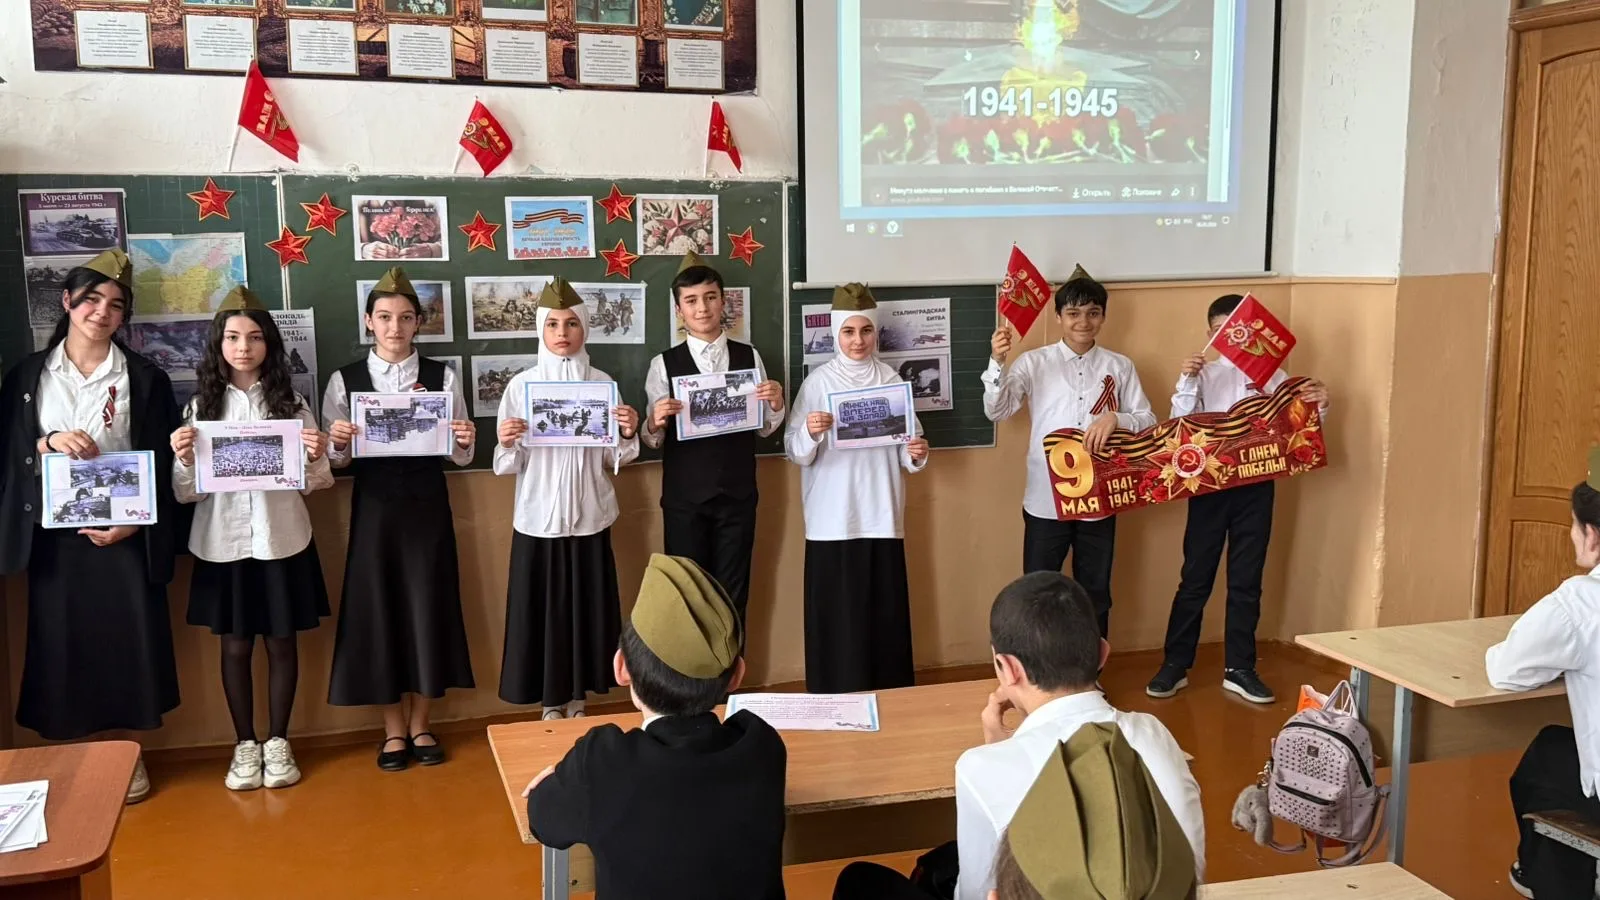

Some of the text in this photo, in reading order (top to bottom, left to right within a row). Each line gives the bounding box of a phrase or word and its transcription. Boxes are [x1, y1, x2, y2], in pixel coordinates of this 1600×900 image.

[963, 86, 1118, 117] 1941-1945
[41, 192, 104, 203] Курская битва
[892, 307, 946, 316] СТАЛИНГРАДСКАЯ
[1260, 327, 1288, 351] МАЯ
[1239, 443, 1279, 463] С ДНЕМ
[1049, 439, 1100, 516] 9 МАЯ
[1237, 457, 1288, 479] ПОБЕДЫ!
[1106, 475, 1138, 495] 1941-
[1108, 490, 1136, 509] 1945
